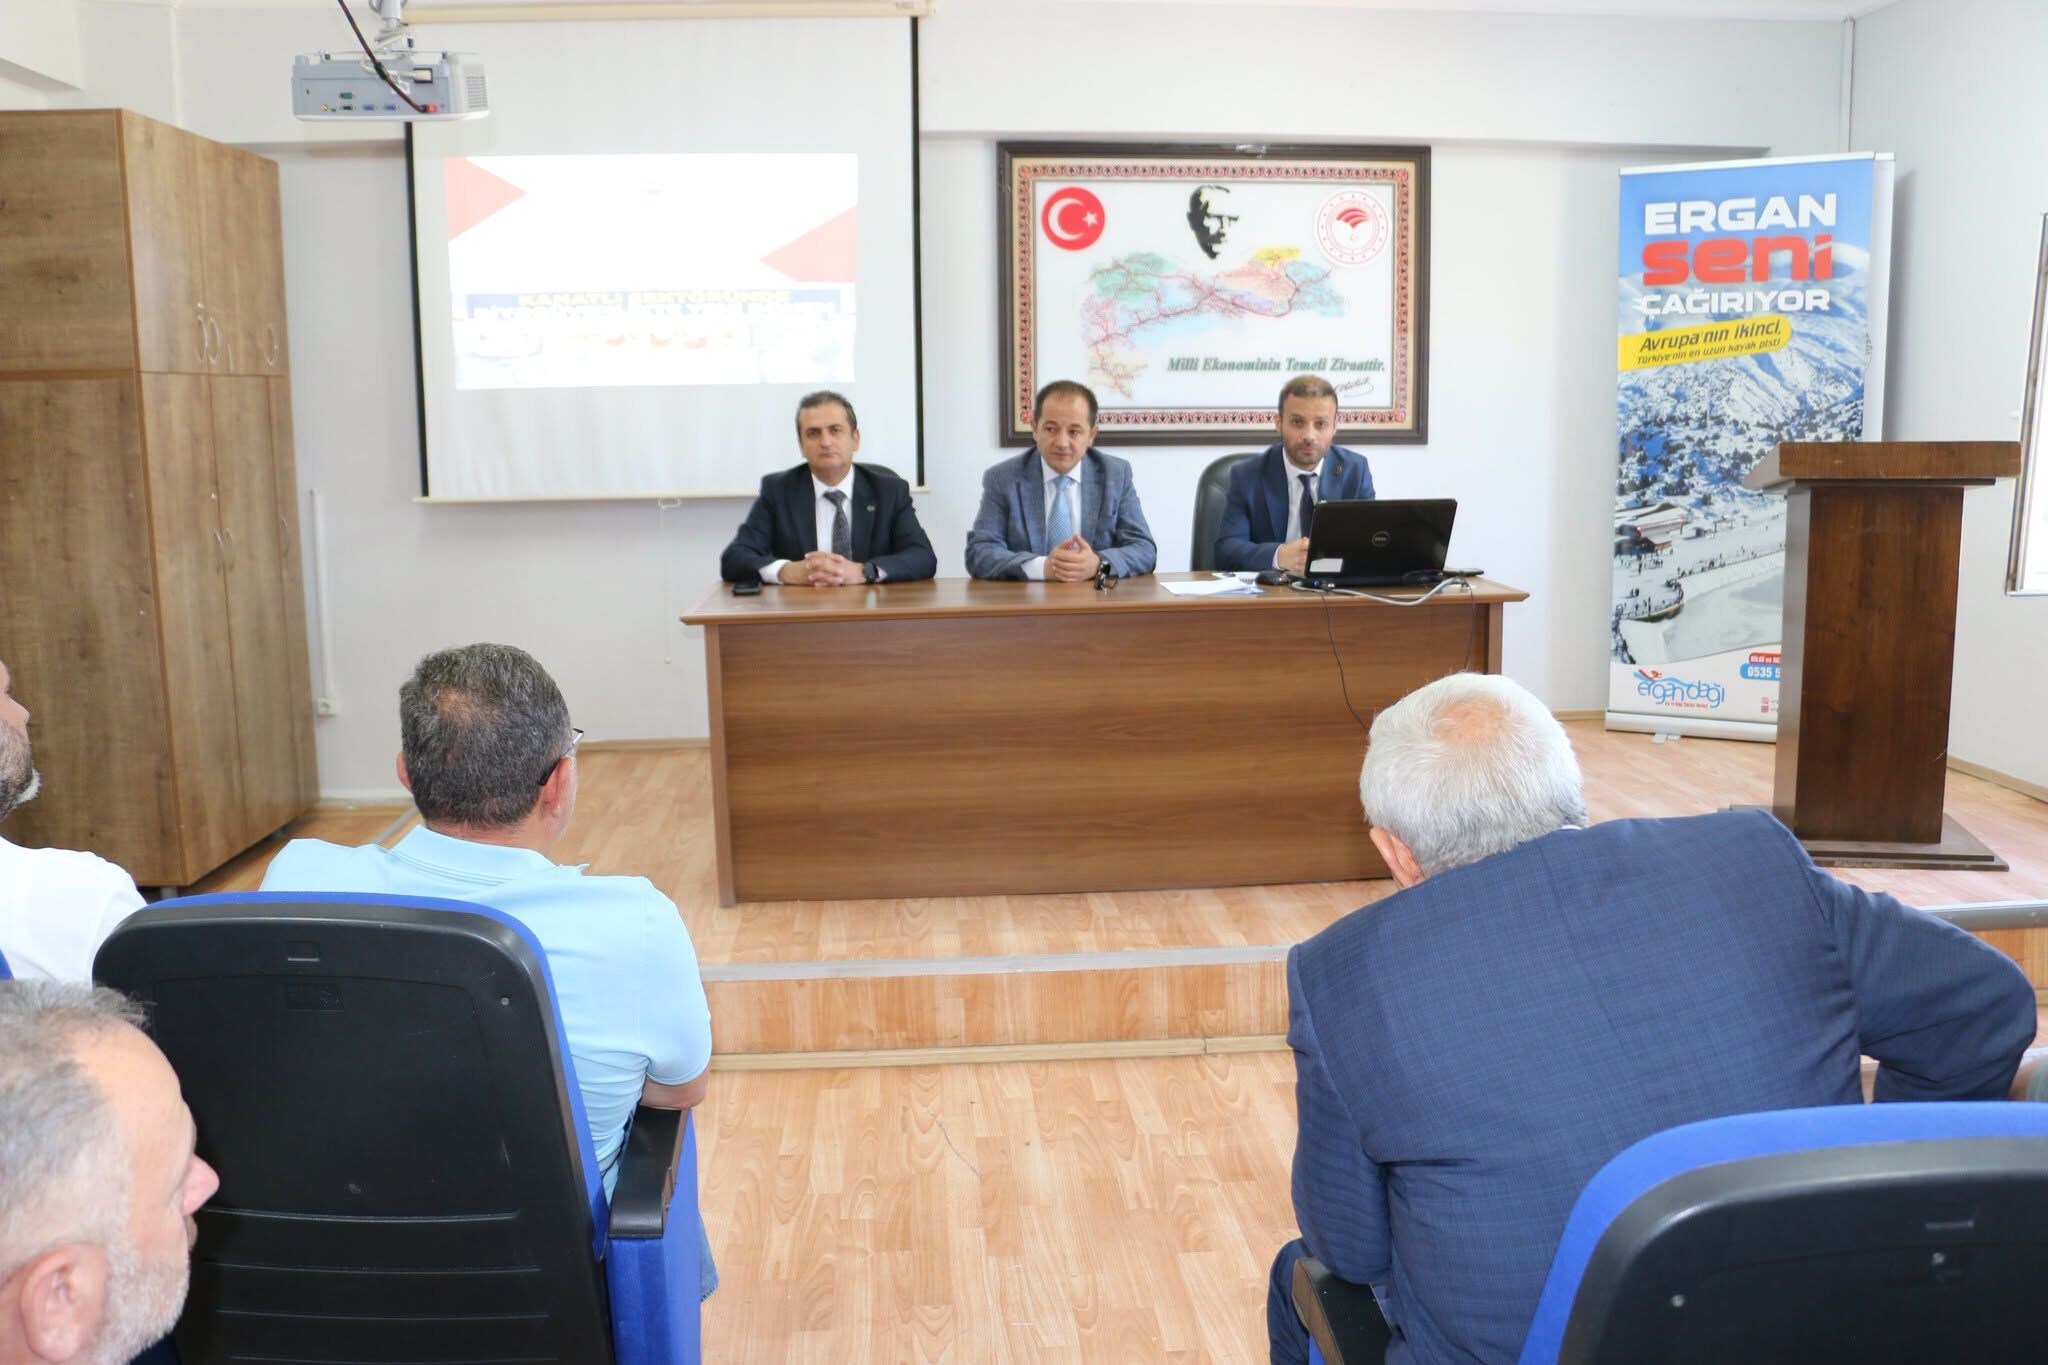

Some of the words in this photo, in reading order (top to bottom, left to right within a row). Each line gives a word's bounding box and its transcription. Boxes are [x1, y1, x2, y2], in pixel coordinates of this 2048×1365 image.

[1644, 193, 1837, 236] ERGAN
[1641, 233, 1834, 286] seni
[1632, 287, 1831, 320] ÇAĞIRIYOR
[1202, 357, 1281, 372] Ekonominin
[1285, 357, 1328, 372] Temeli
[1329, 357, 1386, 372] Ziraattir.
[1747, 665, 1772, 678] 0535
